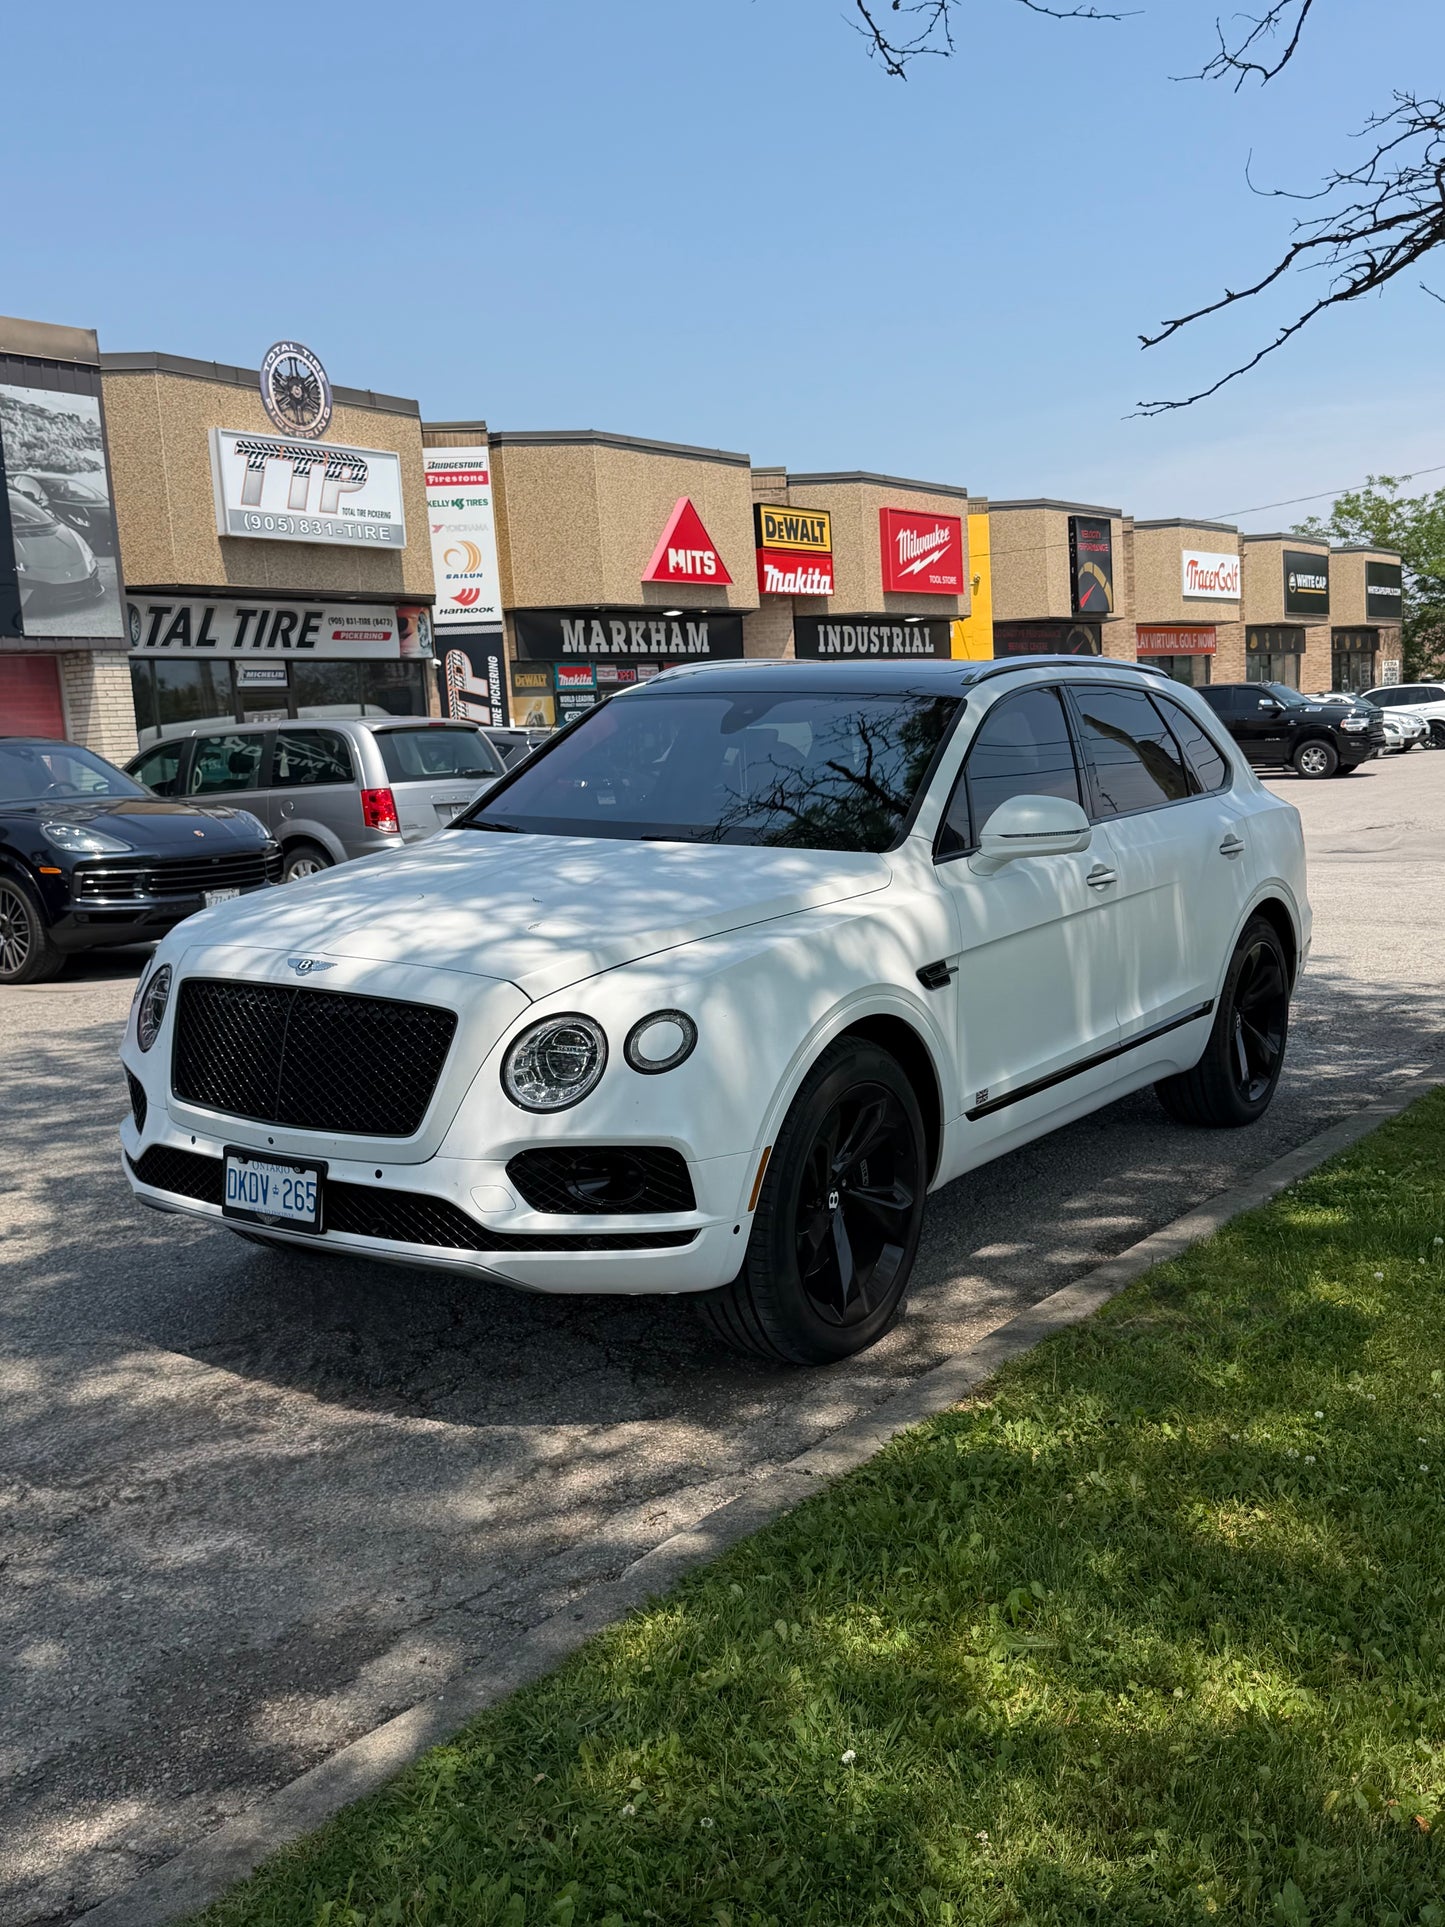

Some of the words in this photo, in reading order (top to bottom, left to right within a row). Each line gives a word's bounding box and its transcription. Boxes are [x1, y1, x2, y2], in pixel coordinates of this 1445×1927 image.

[263, 344, 297, 371] TOTAL
[302, 348, 327, 382] TIRE
[266, 397, 331, 439] PICKERING
[427, 461, 484, 470] BRIDGESTONE
[234, 440, 369, 515] TTP
[427, 475, 485, 485] Firestone
[428, 499, 450, 508] KELLY
[466, 498, 489, 508] TIRES
[342, 507, 356, 517] TOTAL
[357, 509, 367, 518] TIRE
[367, 510, 391, 520] PICKERING
[243, 513, 295, 534] (905)
[300, 519, 391, 541] 831-TIRE
[444, 524, 489, 533] YOKOHAMA
[765, 515, 826, 543] DEWALT
[896, 524, 951, 565] Milwaukee
[668, 548, 717, 576] MITS
[446, 572, 483, 580] SAILUN
[929, 575, 942, 584] TOOL
[942, 575, 957, 585] STORE
[1187, 559, 1239, 592] TracerGolf
[1296, 574, 1315, 588] WHITE
[1315, 576, 1327, 589] CAP
[232, 607, 324, 650] TIRE
[328, 616, 345, 627] (905)
[346, 616, 371, 627] 831-TIRE
[372, 617, 393, 628] (8473)
[340, 631, 384, 641] PICKERING
[560, 619, 711, 653] MARKHAM
[817, 624, 935, 653] INDUSTRIAL
[1150, 632, 1179, 649] VIRTUAL
[1179, 632, 1198, 649] GOLF
[1198, 632, 1215, 648] NOW!
[245, 670, 285, 679] MICHELIN
[487, 655, 502, 706] PICKERING
[617, 670, 636, 681] OPEN
[445, 649, 491, 725] TP
[559, 695, 575, 703] WORLD
[575, 694, 595, 703] LEADING
[252, 1162, 290, 1174] ONTARIO
[227, 1168, 269, 1205] DKDV
[282, 1178, 316, 1213] 265
